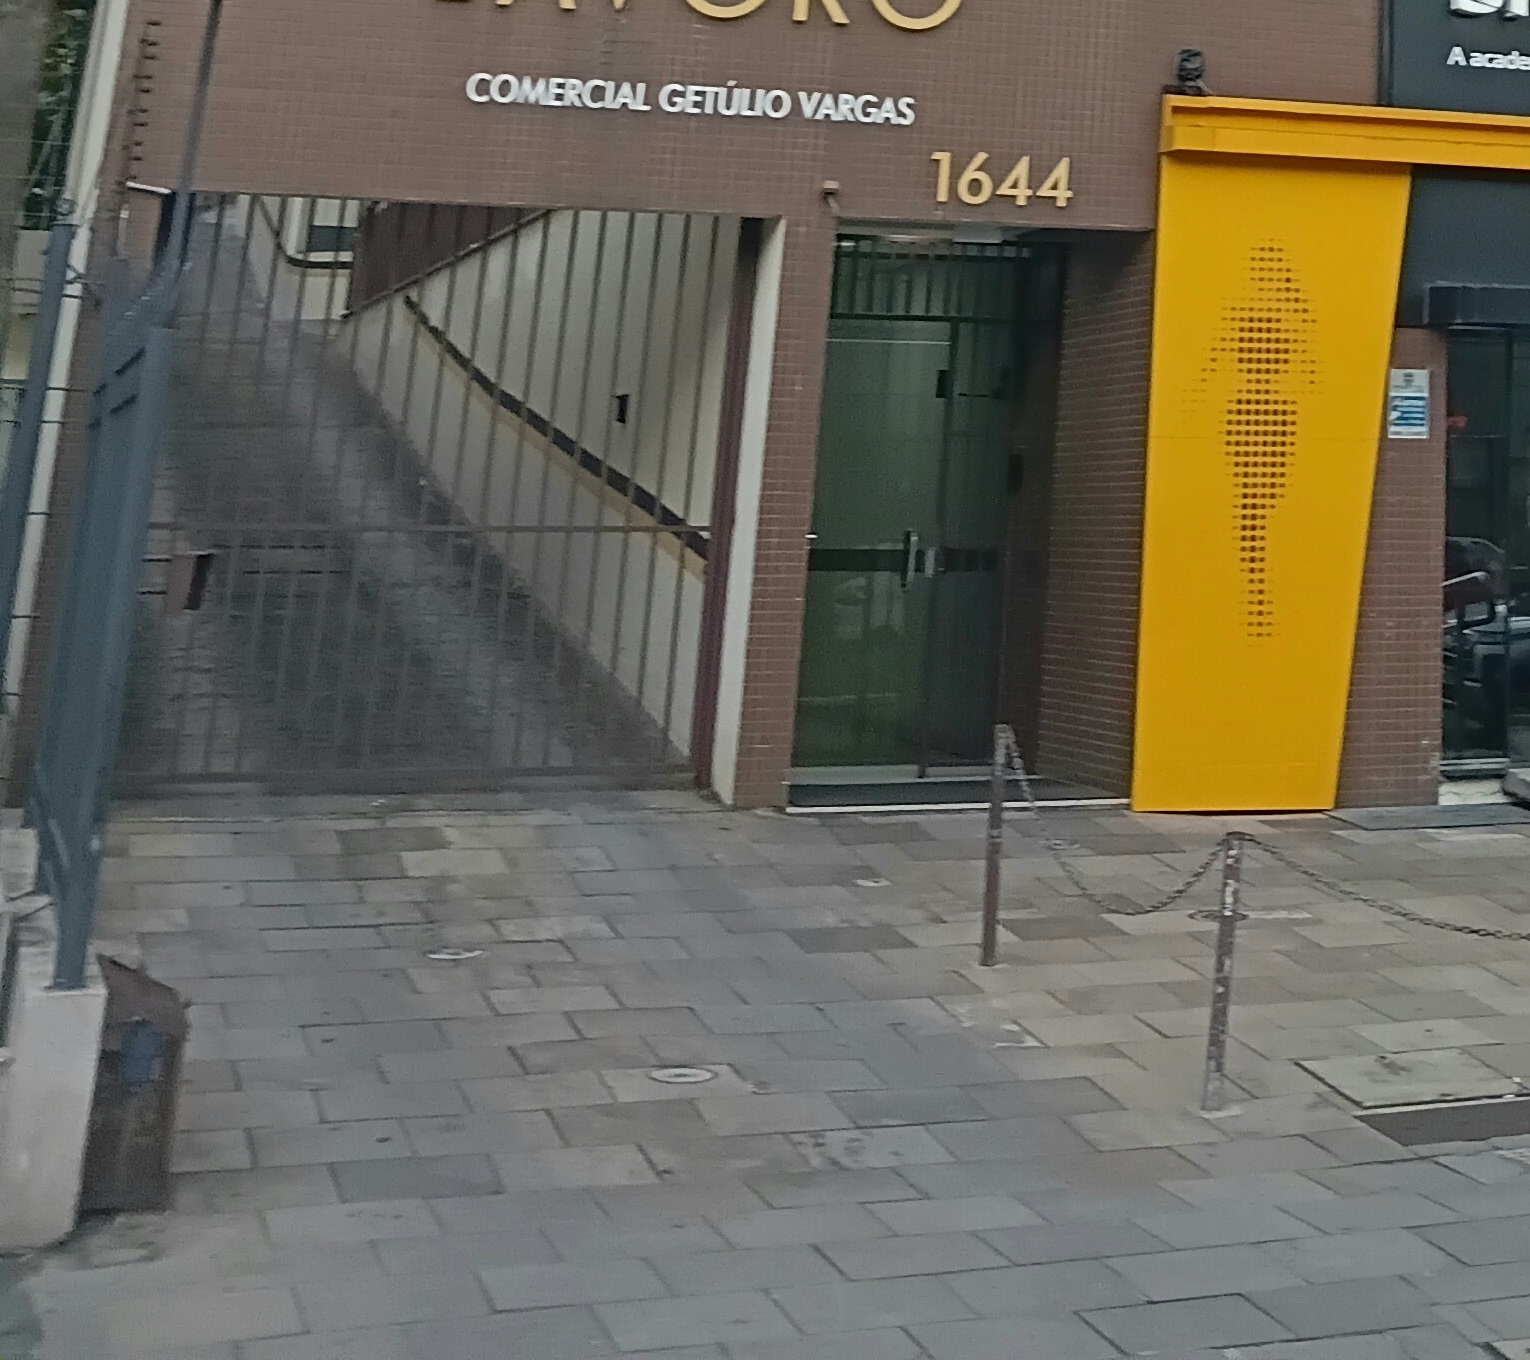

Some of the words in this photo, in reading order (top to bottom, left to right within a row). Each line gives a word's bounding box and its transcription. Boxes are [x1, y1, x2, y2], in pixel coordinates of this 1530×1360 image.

[1446, 46, 1468, 66] A
[465, 72, 652, 112] COMERCIAL
[657, 80, 792, 119] GETÚLIO
[797, 91, 918, 126] VARGAS
[929, 150, 1075, 208] 1644
